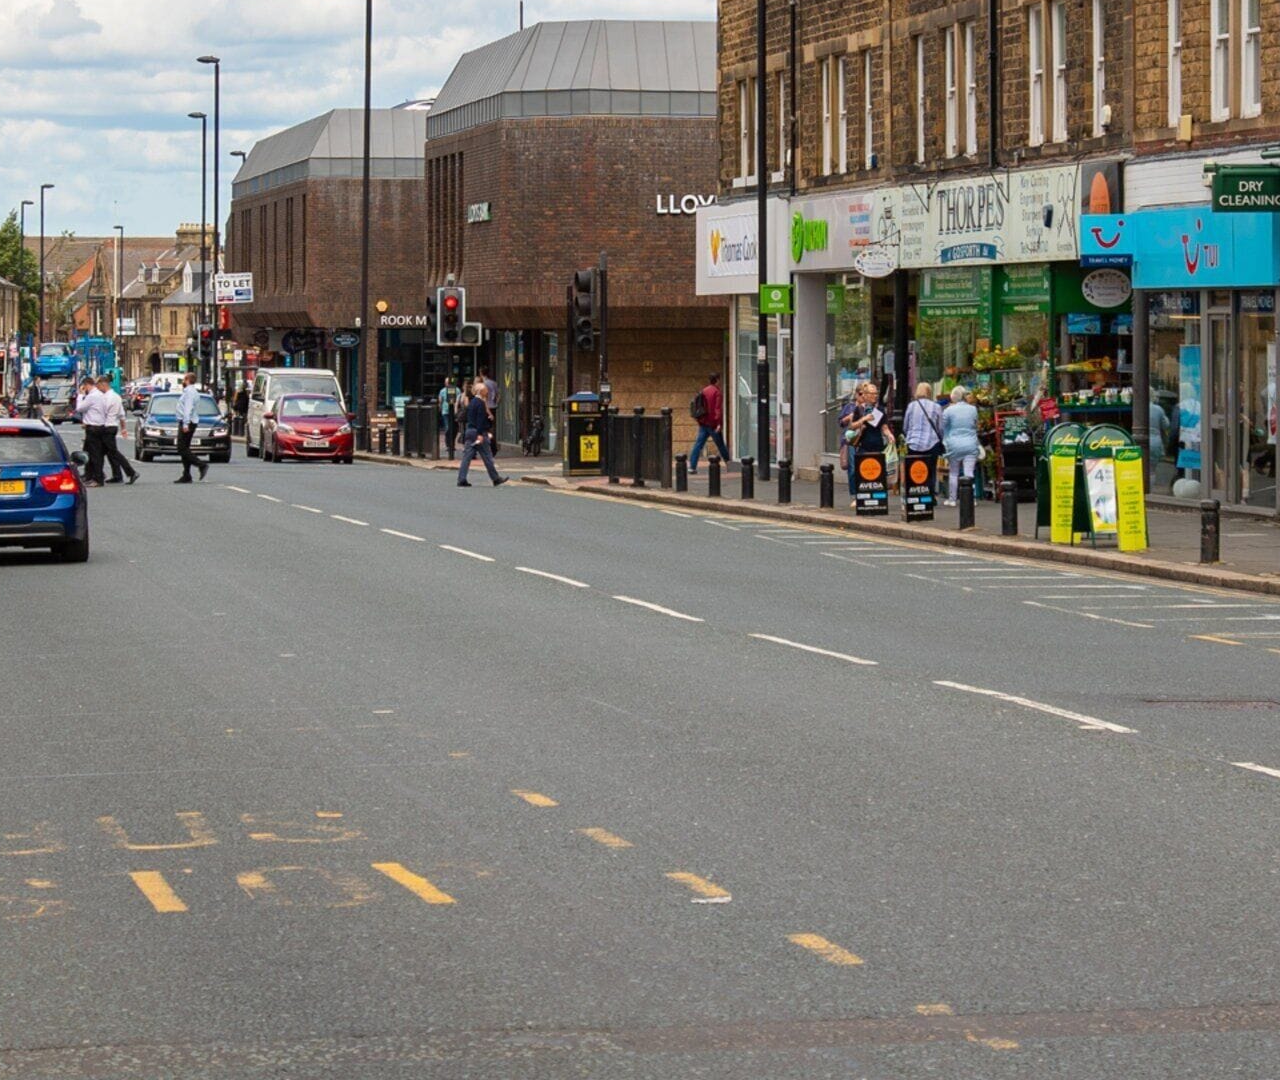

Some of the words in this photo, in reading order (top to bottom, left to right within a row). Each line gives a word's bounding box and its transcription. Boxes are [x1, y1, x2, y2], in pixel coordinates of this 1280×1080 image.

[1238, 180, 1264, 192] DRY
[656, 194, 717, 214] LLOY
[937, 182, 1005, 231] THORPES
[721, 237, 743, 263] Thomas
[1204, 245, 1218, 267] TUI
[218, 280, 229, 288] TO
[233, 280, 251, 288] LET
[380, 316, 413, 326] ROOK
[415, 315, 428, 326] M
[1094, 469, 1105, 482] 4
[860, 482, 884, 490] AVEDA
